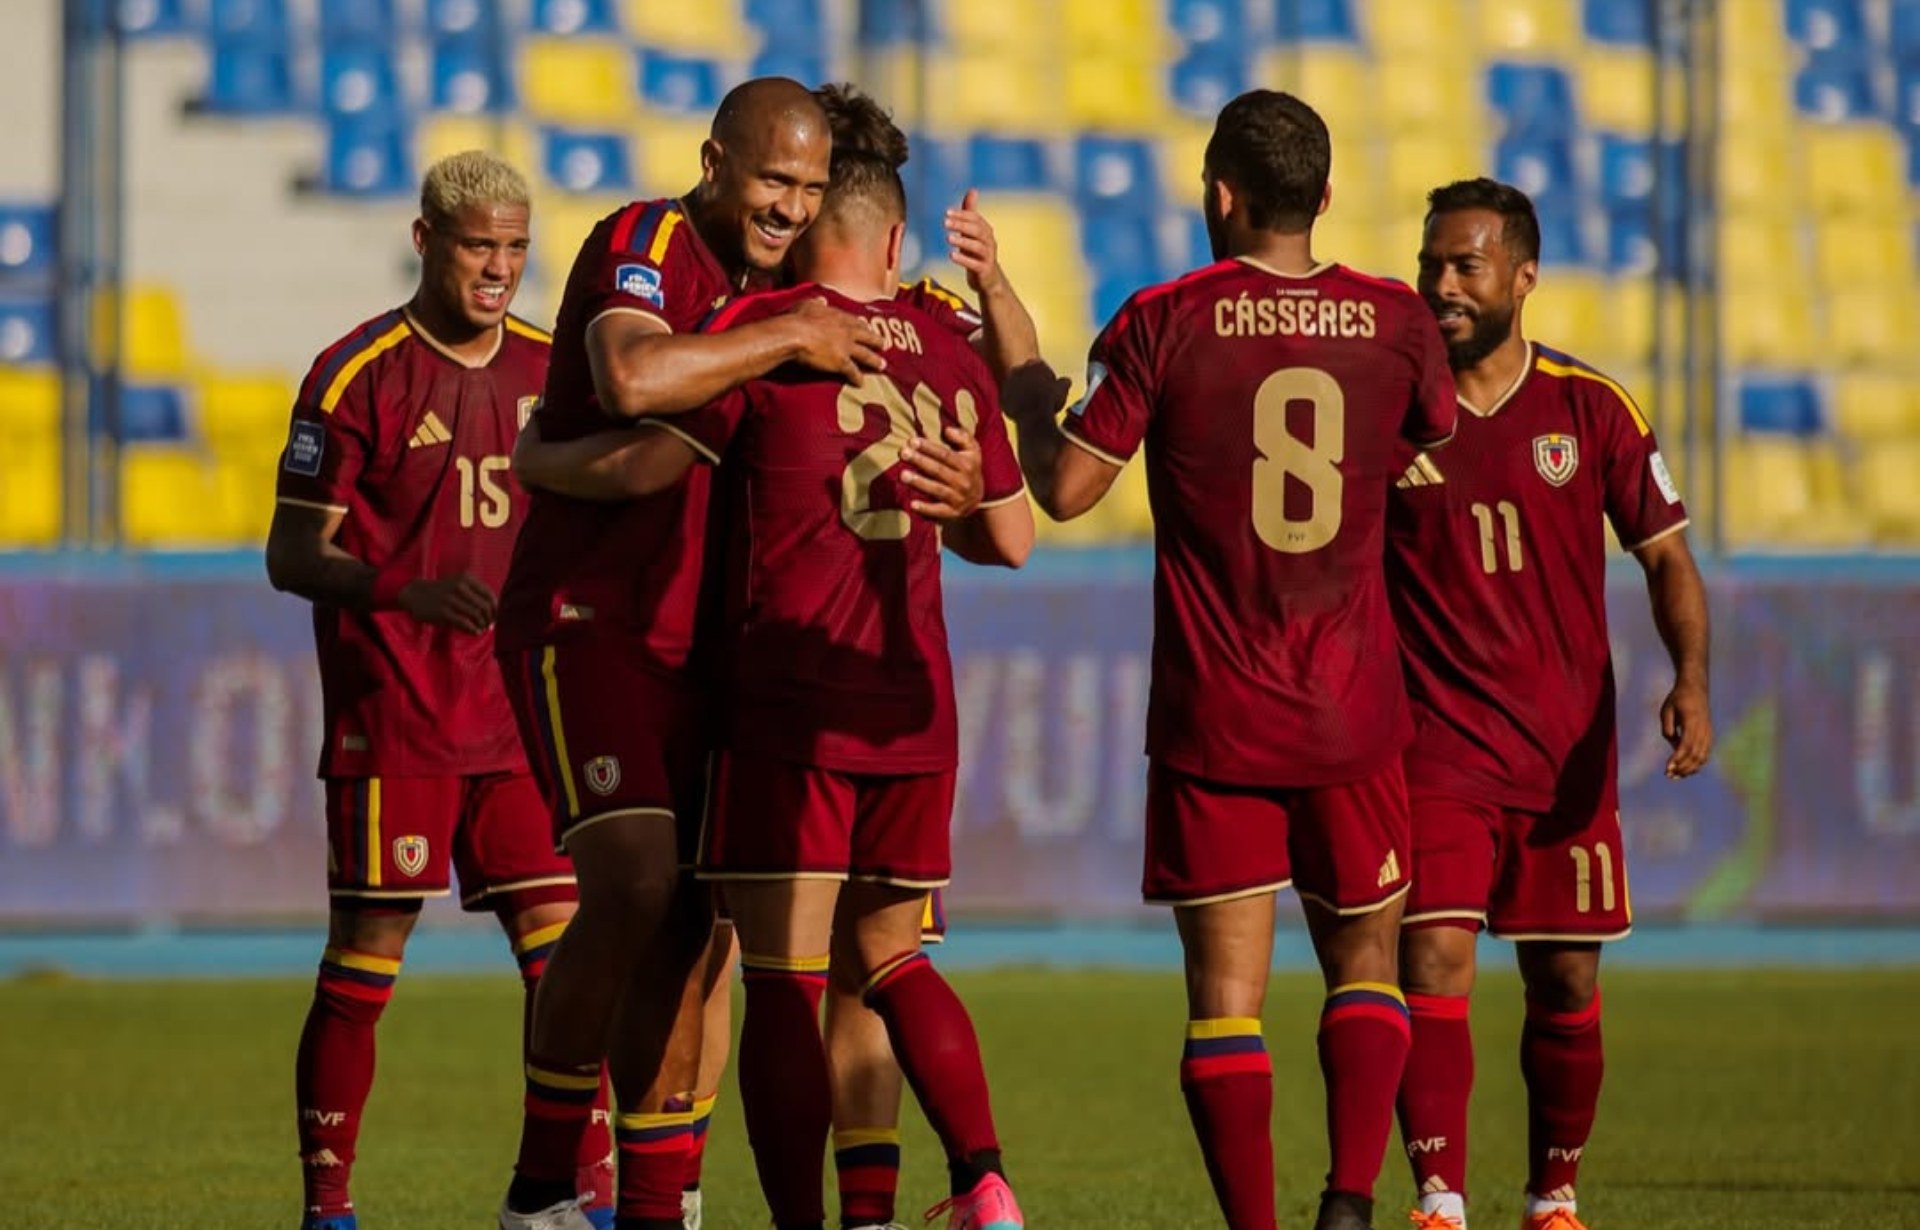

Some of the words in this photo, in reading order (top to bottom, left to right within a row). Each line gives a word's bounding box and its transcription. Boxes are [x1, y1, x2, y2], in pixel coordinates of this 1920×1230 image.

[857, 316, 923, 355] OSA
[1215, 290, 1376, 338] CÁSSERES
[1252, 366, 1345, 554] 8
[456, 456, 510, 528] 15
[1471, 500, 1523, 573] 11
[1569, 842, 1615, 913] 11
[1407, 1136, 1448, 1158] FVF
[1548, 1146, 1584, 1163] FVF
